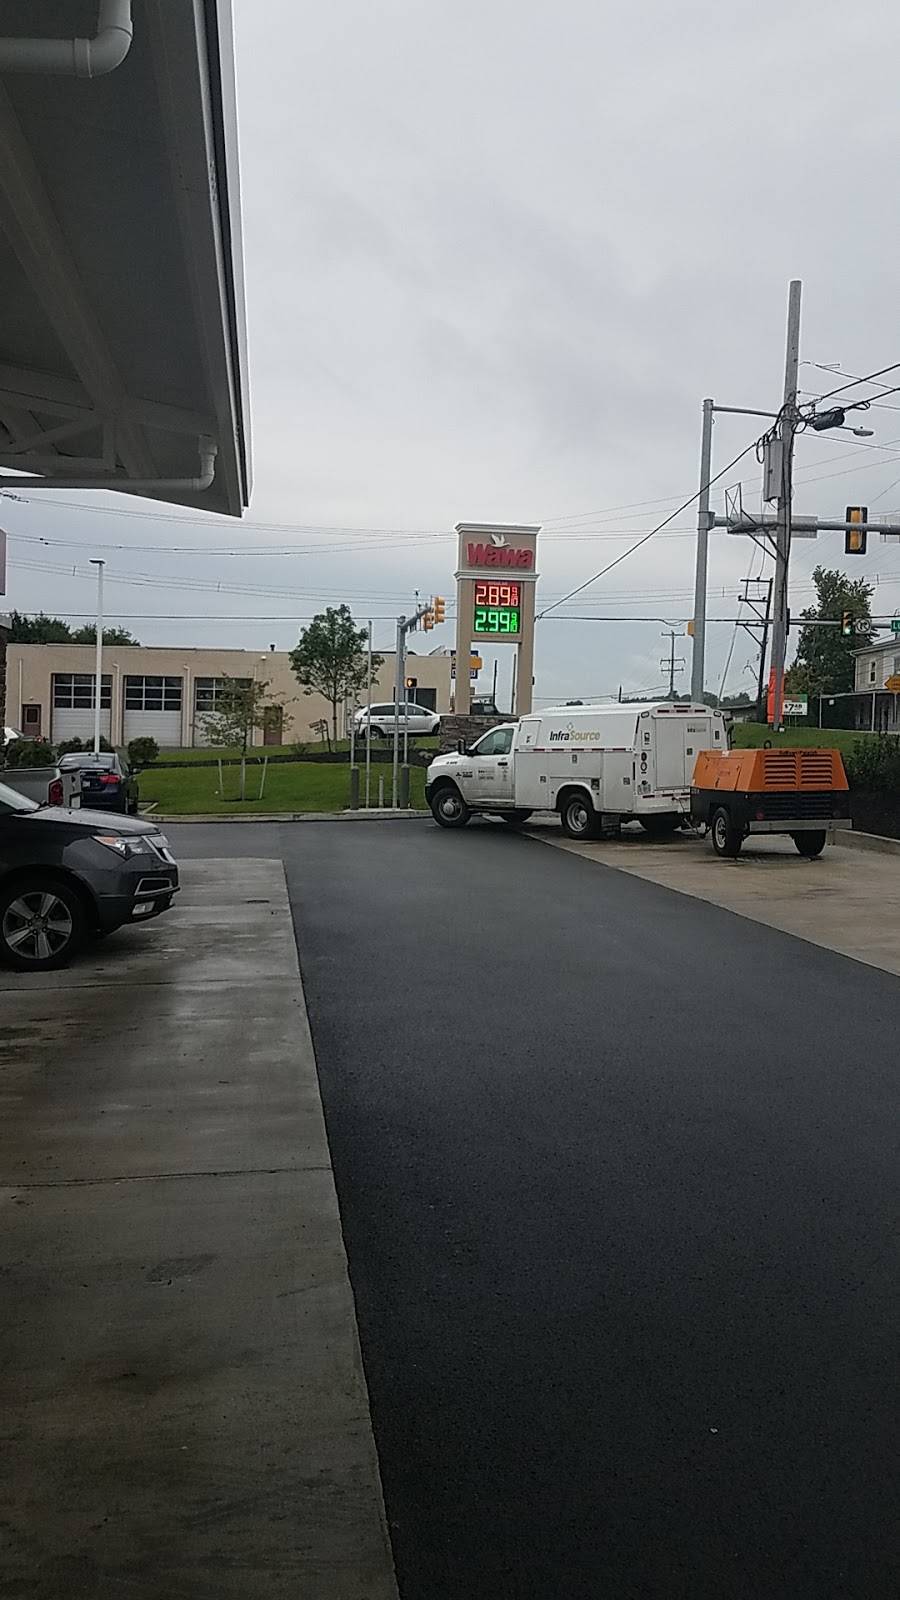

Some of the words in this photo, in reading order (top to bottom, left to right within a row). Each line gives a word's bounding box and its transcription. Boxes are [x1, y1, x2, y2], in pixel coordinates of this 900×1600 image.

[467, 543, 533, 569] Wawa
[476, 585, 510, 606] 2.89
[475, 611, 510, 632] 2.99
[549, 730, 601, 741] InfraSource
